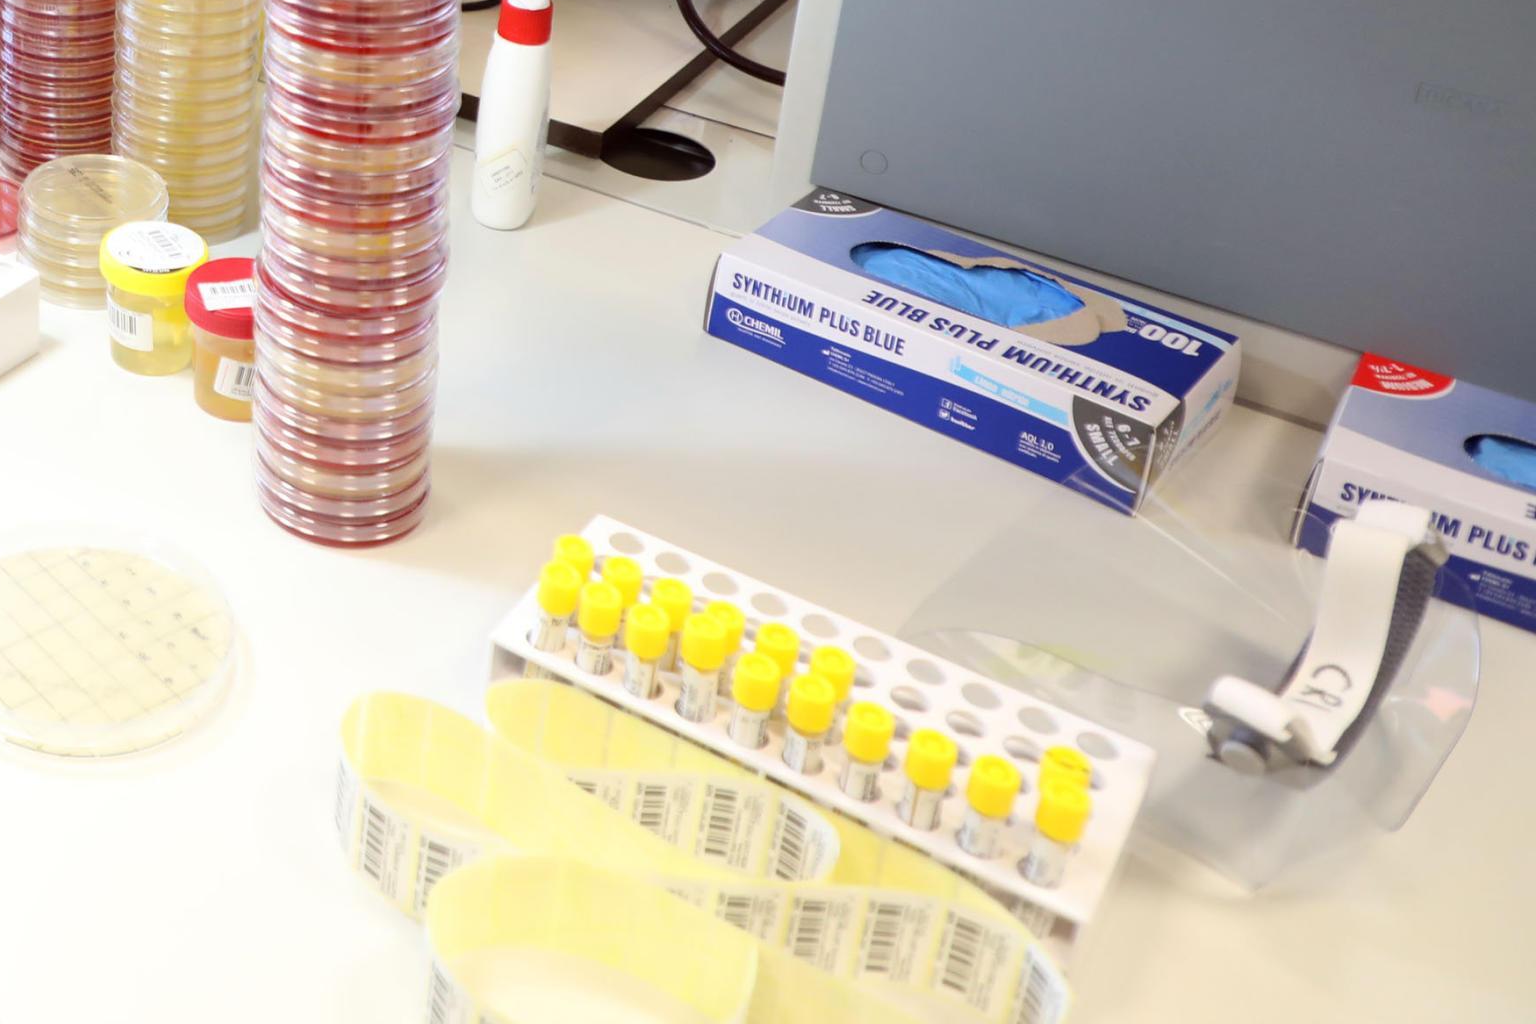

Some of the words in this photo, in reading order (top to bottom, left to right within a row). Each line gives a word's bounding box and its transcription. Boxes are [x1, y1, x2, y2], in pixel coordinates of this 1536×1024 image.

[861, 289, 930, 323] BLUE
[744, 314, 785, 340] CHEMIL
[818, 306, 861, 337] PLUS
[862, 325, 906, 356] BLUE
[929, 317, 999, 352] PLUS
[1135, 322, 1204, 357] 100
[1085, 423, 1119, 467] SMALL
[1468, 525, 1530, 562] PLUS
